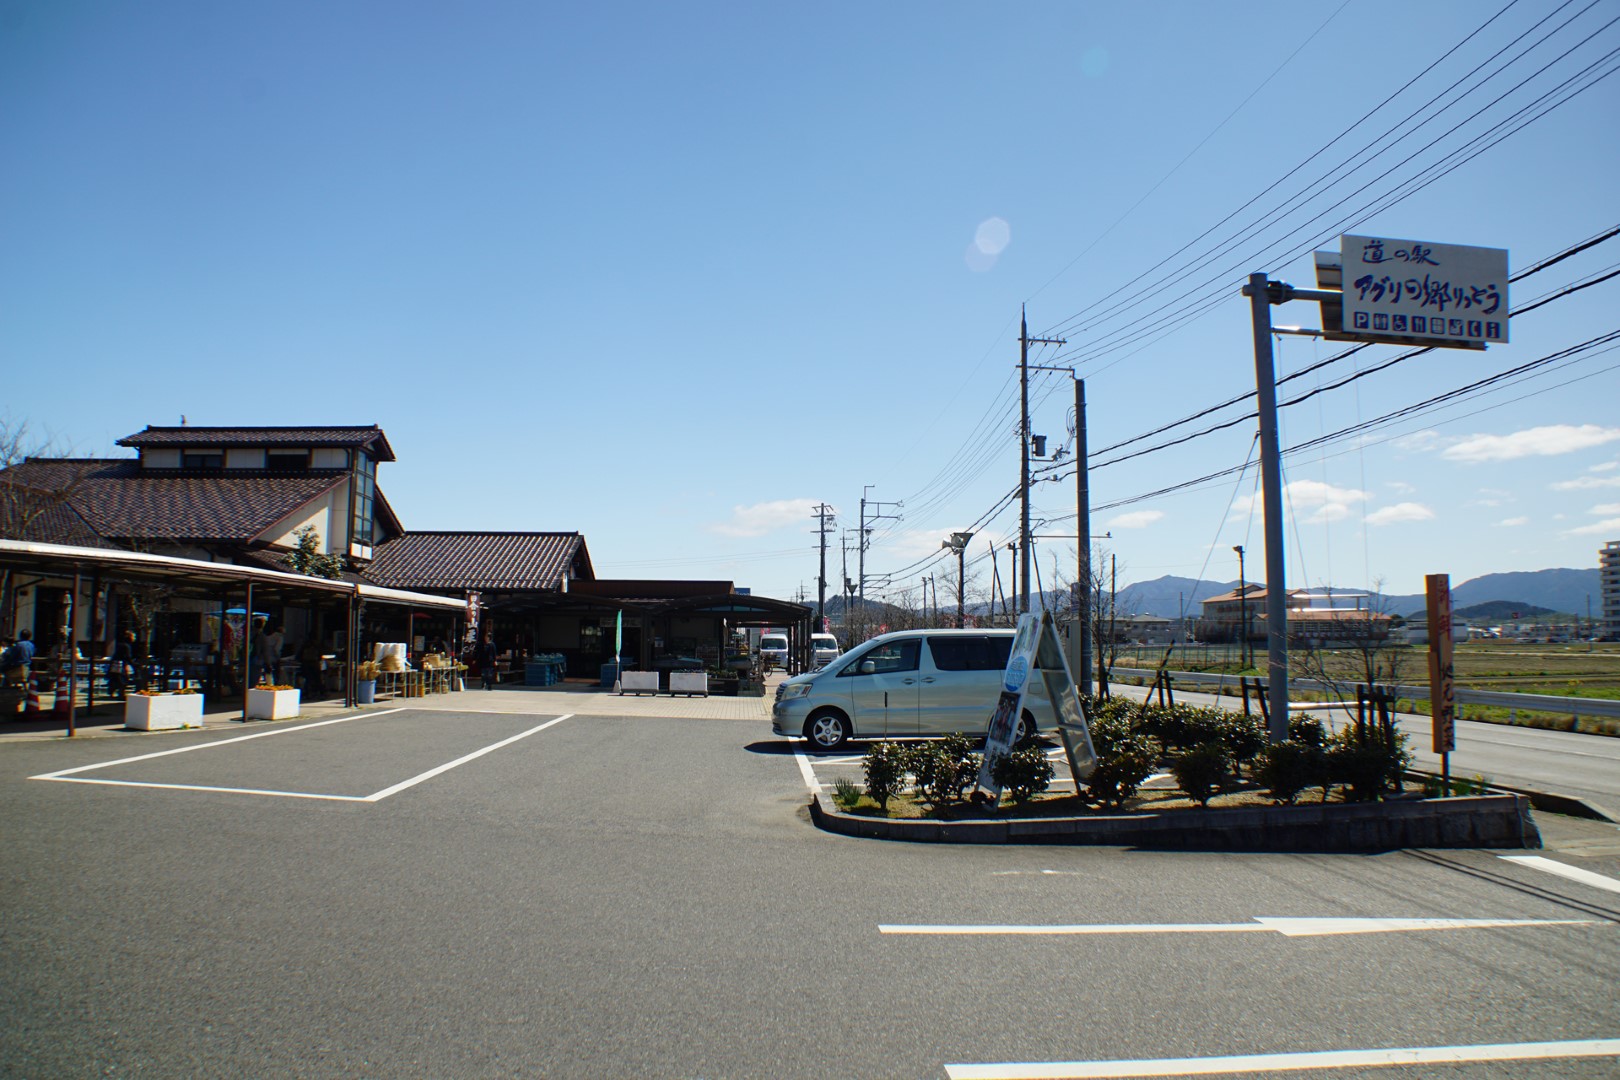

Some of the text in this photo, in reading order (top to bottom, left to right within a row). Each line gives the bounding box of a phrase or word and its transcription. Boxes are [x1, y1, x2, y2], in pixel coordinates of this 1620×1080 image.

[1362, 240, 1440, 265] 道の駅
[1354, 273, 1501, 315] アグリの郷りっとう
